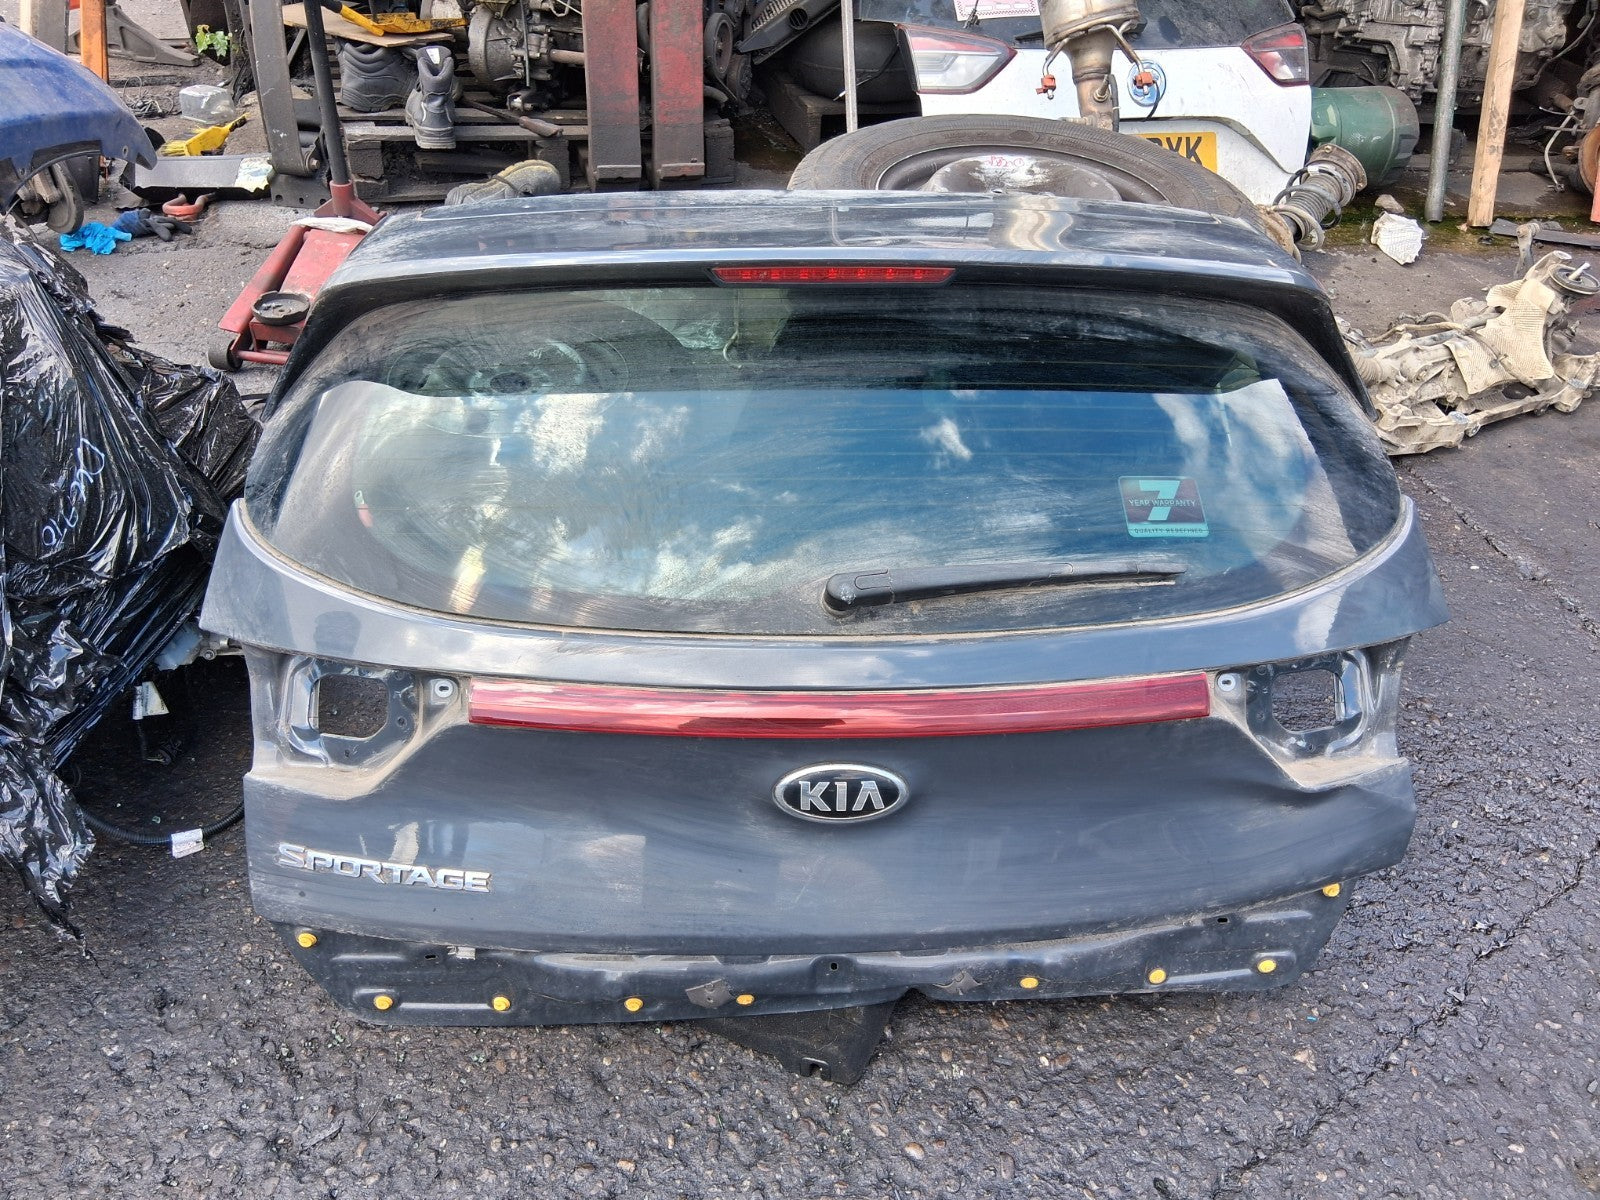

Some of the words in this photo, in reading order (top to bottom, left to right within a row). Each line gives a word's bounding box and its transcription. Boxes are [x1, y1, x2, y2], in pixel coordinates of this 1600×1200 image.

[1128, 499, 1150, 507] YEAR
[1152, 499, 1196, 507] WARRANTY
[1139, 480, 1180, 520] 7
[798, 780, 885, 812] KIA
[278, 842, 493, 893] SPORTAGE
